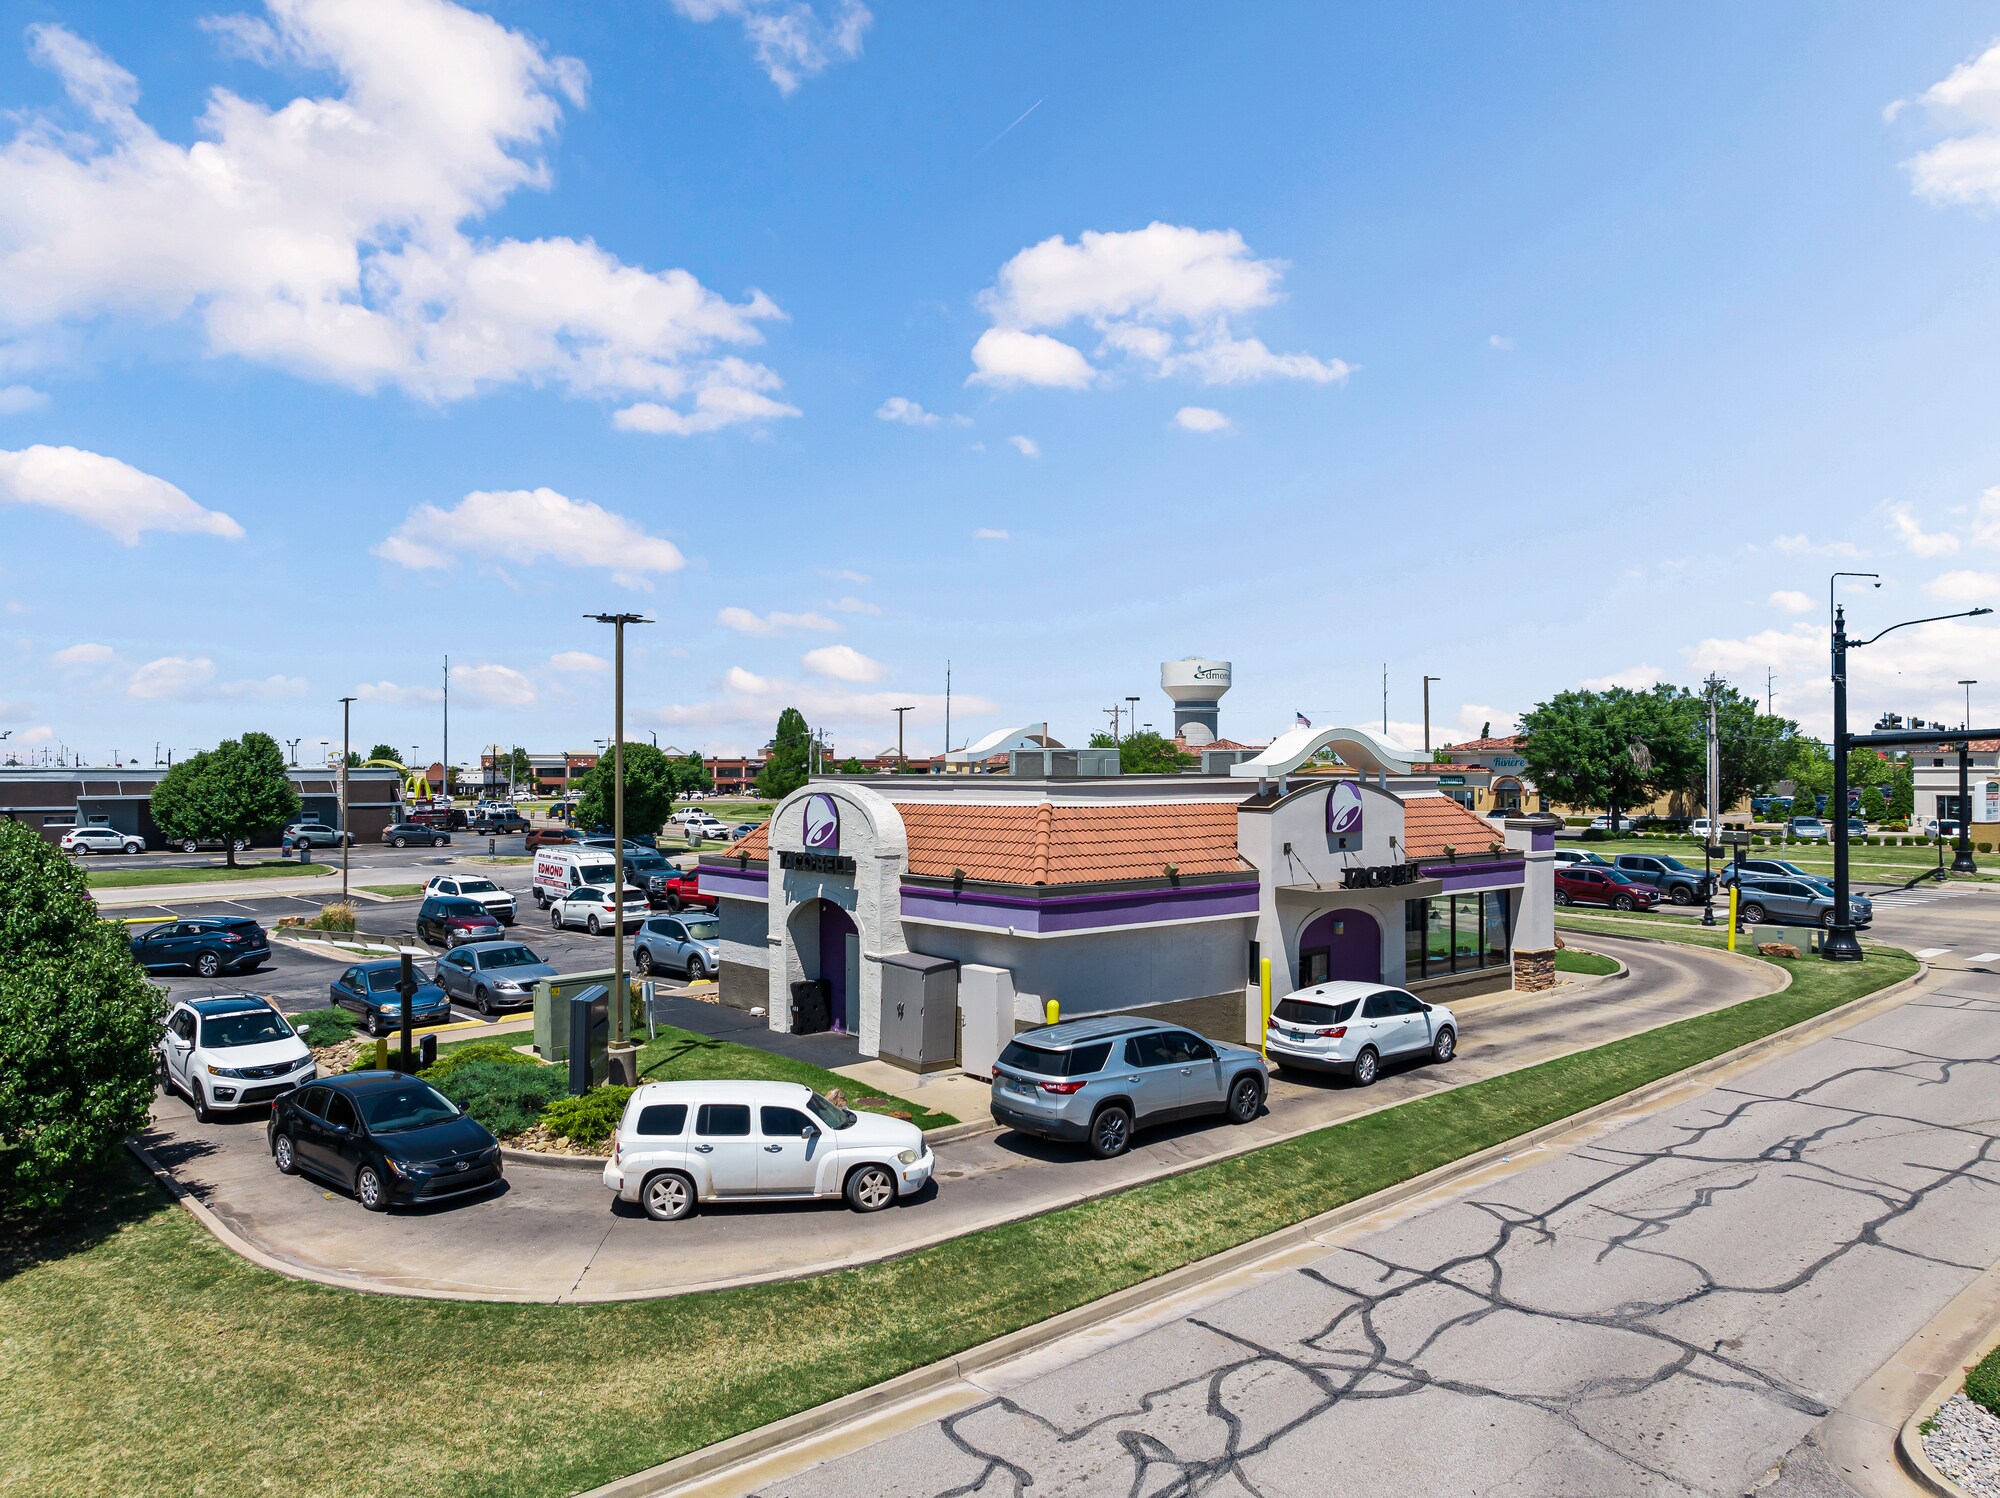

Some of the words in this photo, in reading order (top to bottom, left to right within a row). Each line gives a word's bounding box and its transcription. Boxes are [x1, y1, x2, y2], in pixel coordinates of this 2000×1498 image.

[1493, 757, 1526, 767] Rivière
[538, 862, 564, 878] EDMOND
[777, 850, 814, 872] TACO
[815, 855, 857, 876] BELL
[1341, 866, 1392, 888] TACO
